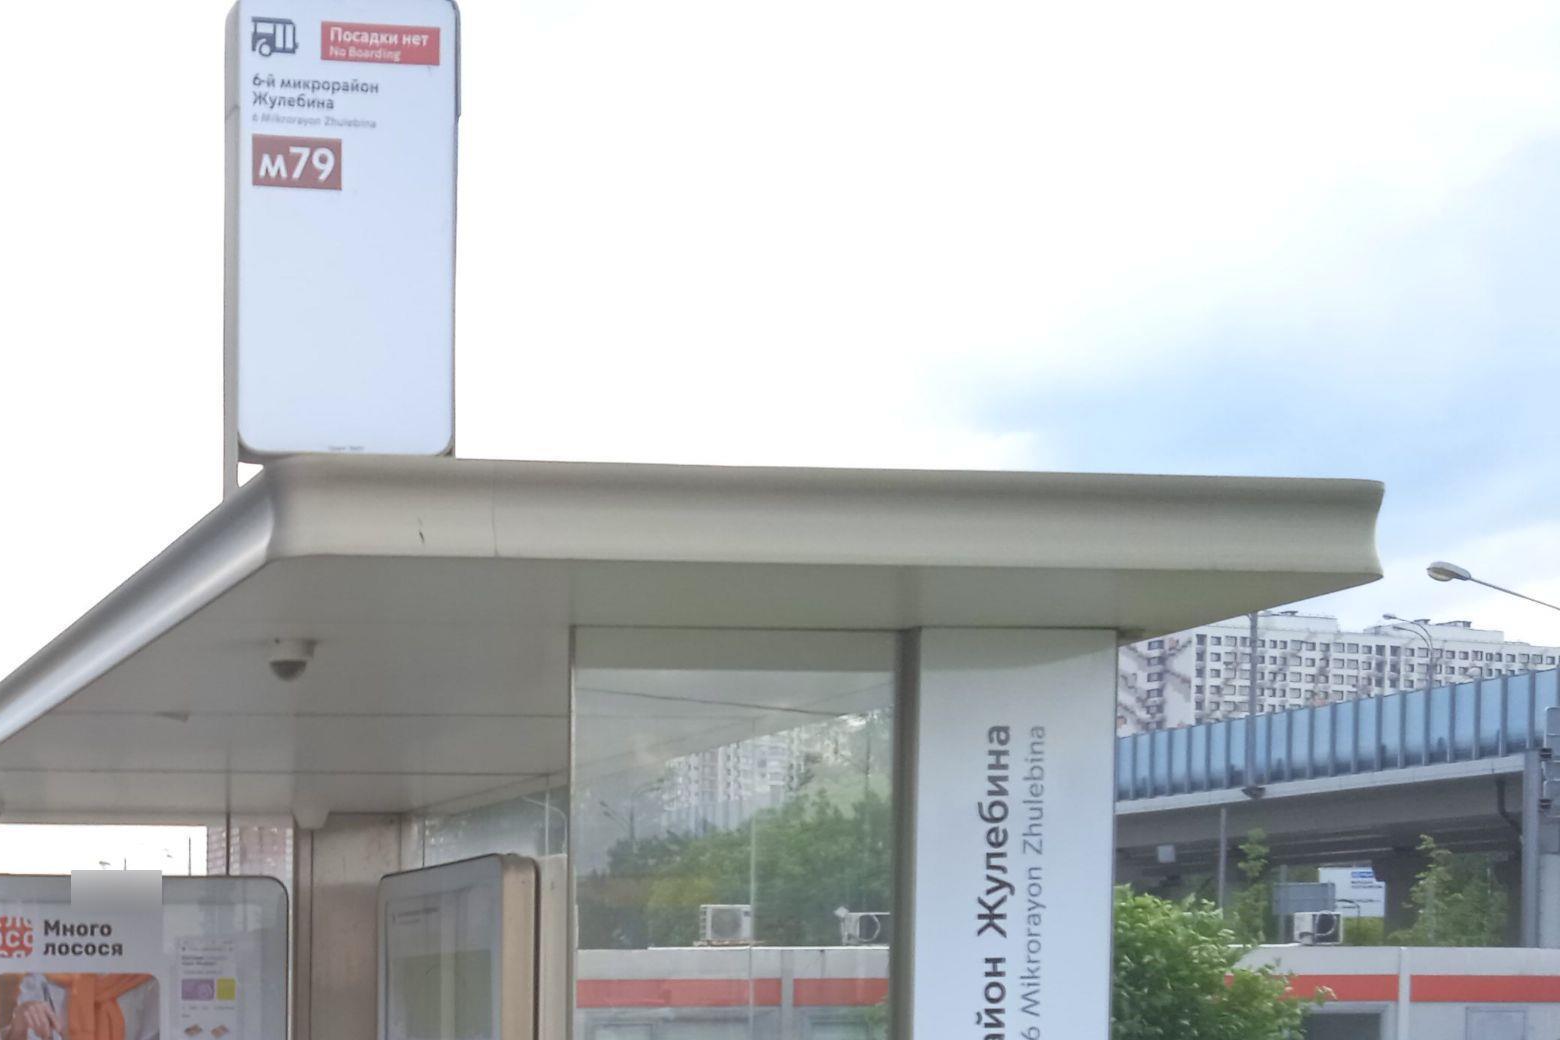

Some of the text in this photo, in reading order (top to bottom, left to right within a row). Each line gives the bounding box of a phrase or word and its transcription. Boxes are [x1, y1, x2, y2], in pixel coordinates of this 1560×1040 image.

[329, 26, 429, 47] Посадки нет
[329, 45, 401, 62] No Boarding
[252, 73, 379, 95] 6-й микрорайон
[252, 91, 335, 110] Жулебина
[258, 146, 335, 183] м79
[977, 725, 1015, 938] Жулебина
[1020, 725, 1046, 1040] 6 Mikrorayon Zhulebina
[43, 919, 113, 937] Много
[43, 942, 123, 956] лосося
